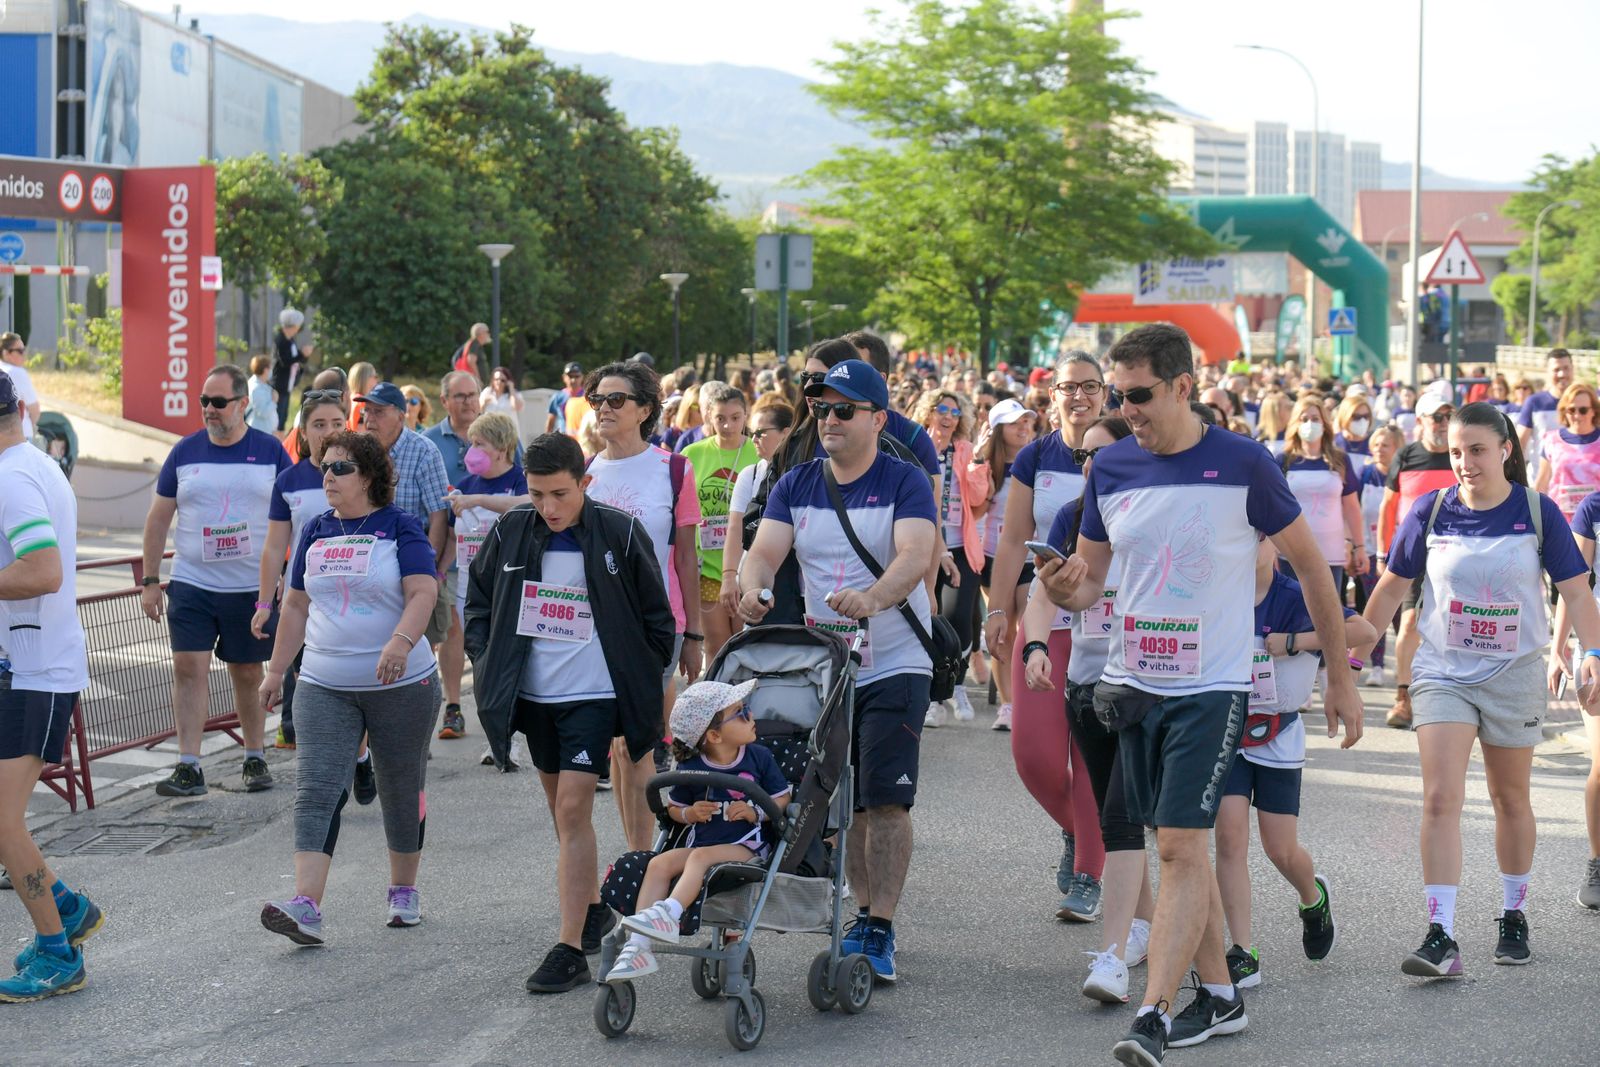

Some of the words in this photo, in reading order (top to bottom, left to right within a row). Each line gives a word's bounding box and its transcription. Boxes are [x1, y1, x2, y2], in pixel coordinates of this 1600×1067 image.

[64, 182, 80, 199] 20
[1167, 286, 1229, 300] SALIDA
[161, 183, 188, 417] Bienvenidos
[712, 527, 727, 537] 761
[216, 536, 238, 548] 7705
[323, 547, 354, 560] 4040
[539, 602, 575, 620] 4986
[1462, 605, 1519, 616] COVIRAN
[547, 626, 574, 635] vithas
[815, 622, 858, 632] COVIRA
[1135, 620, 1199, 632] COVIRAN
[1471, 619, 1497, 635] 525
[1139, 636, 1178, 655] 4039
[1475, 641, 1502, 650] vithas
[1149, 662, 1180, 671] vithas
[1523, 720, 1538, 728] PUMA
